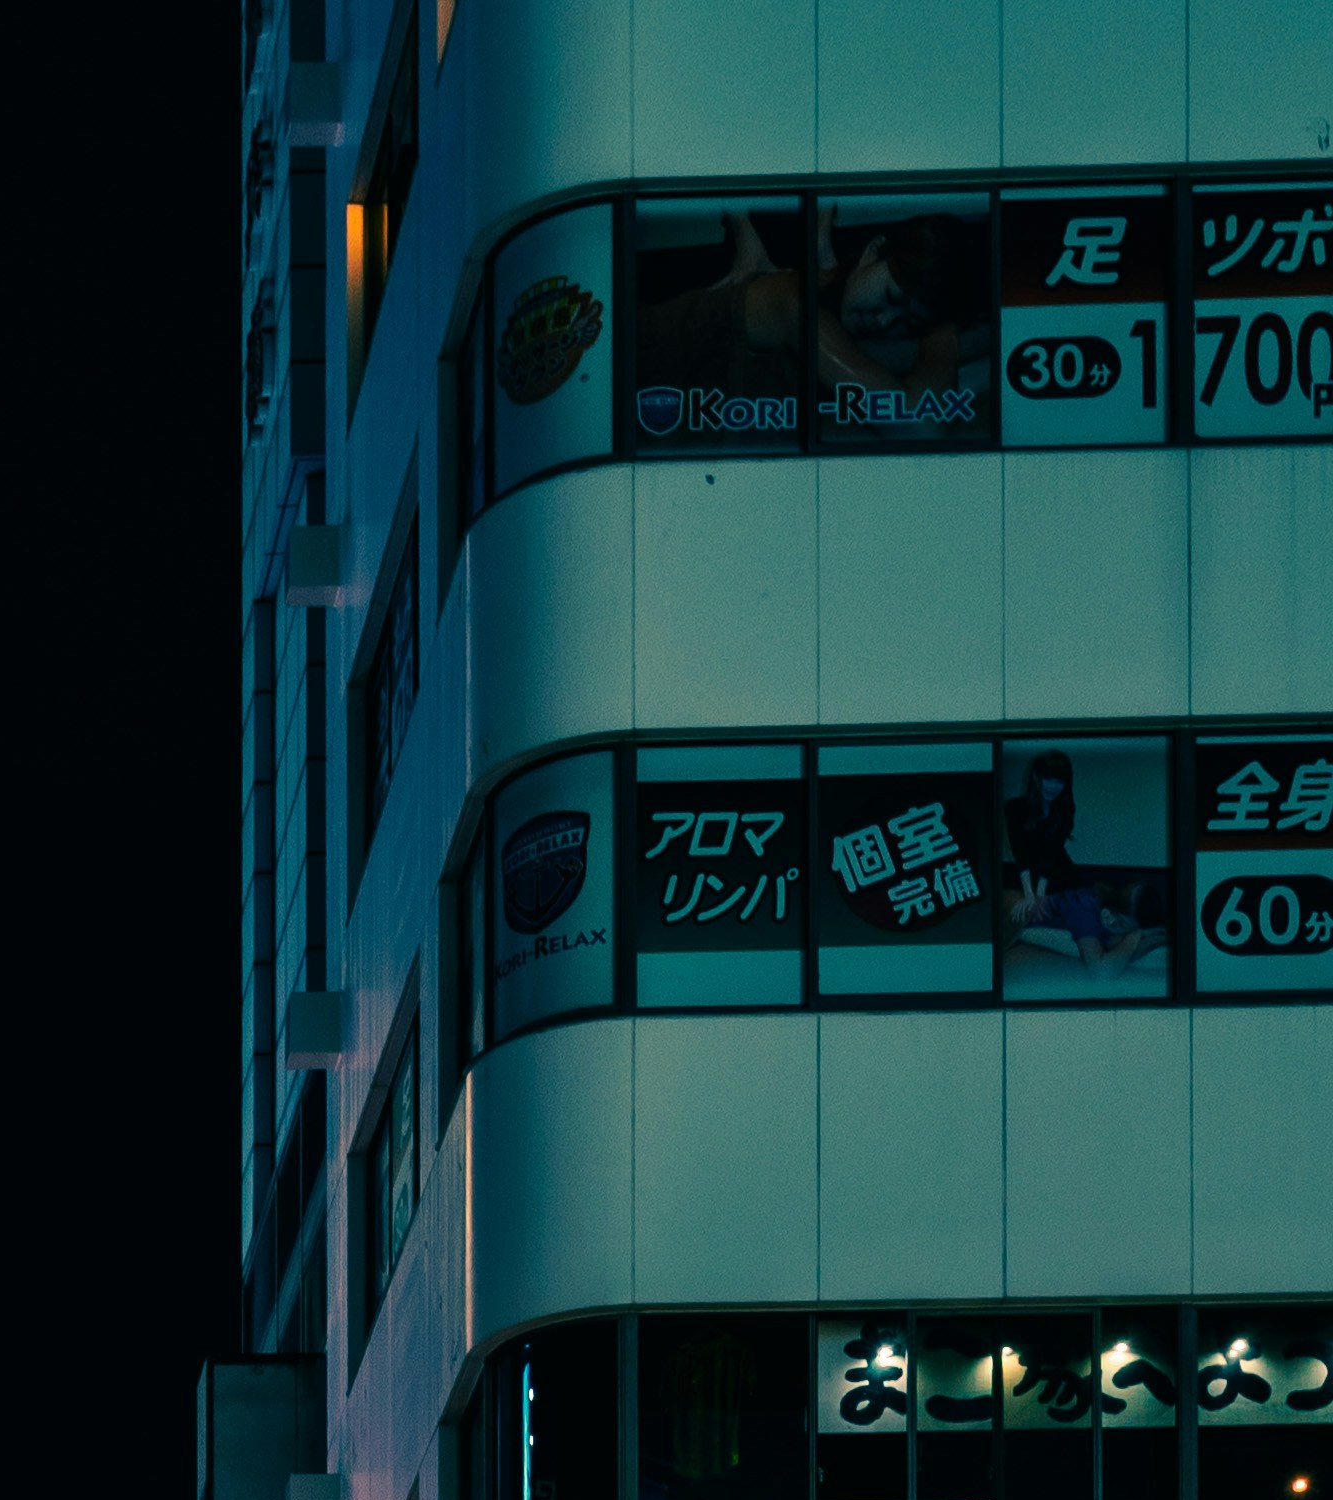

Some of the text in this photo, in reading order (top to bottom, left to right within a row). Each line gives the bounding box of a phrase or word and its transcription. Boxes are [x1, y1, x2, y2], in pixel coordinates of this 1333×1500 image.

[644, 811, 786, 860] アロマ
[832, 801, 961, 893] 個室
[663, 866, 800, 925] リンパ
[885, 859, 982, 926] 完備
